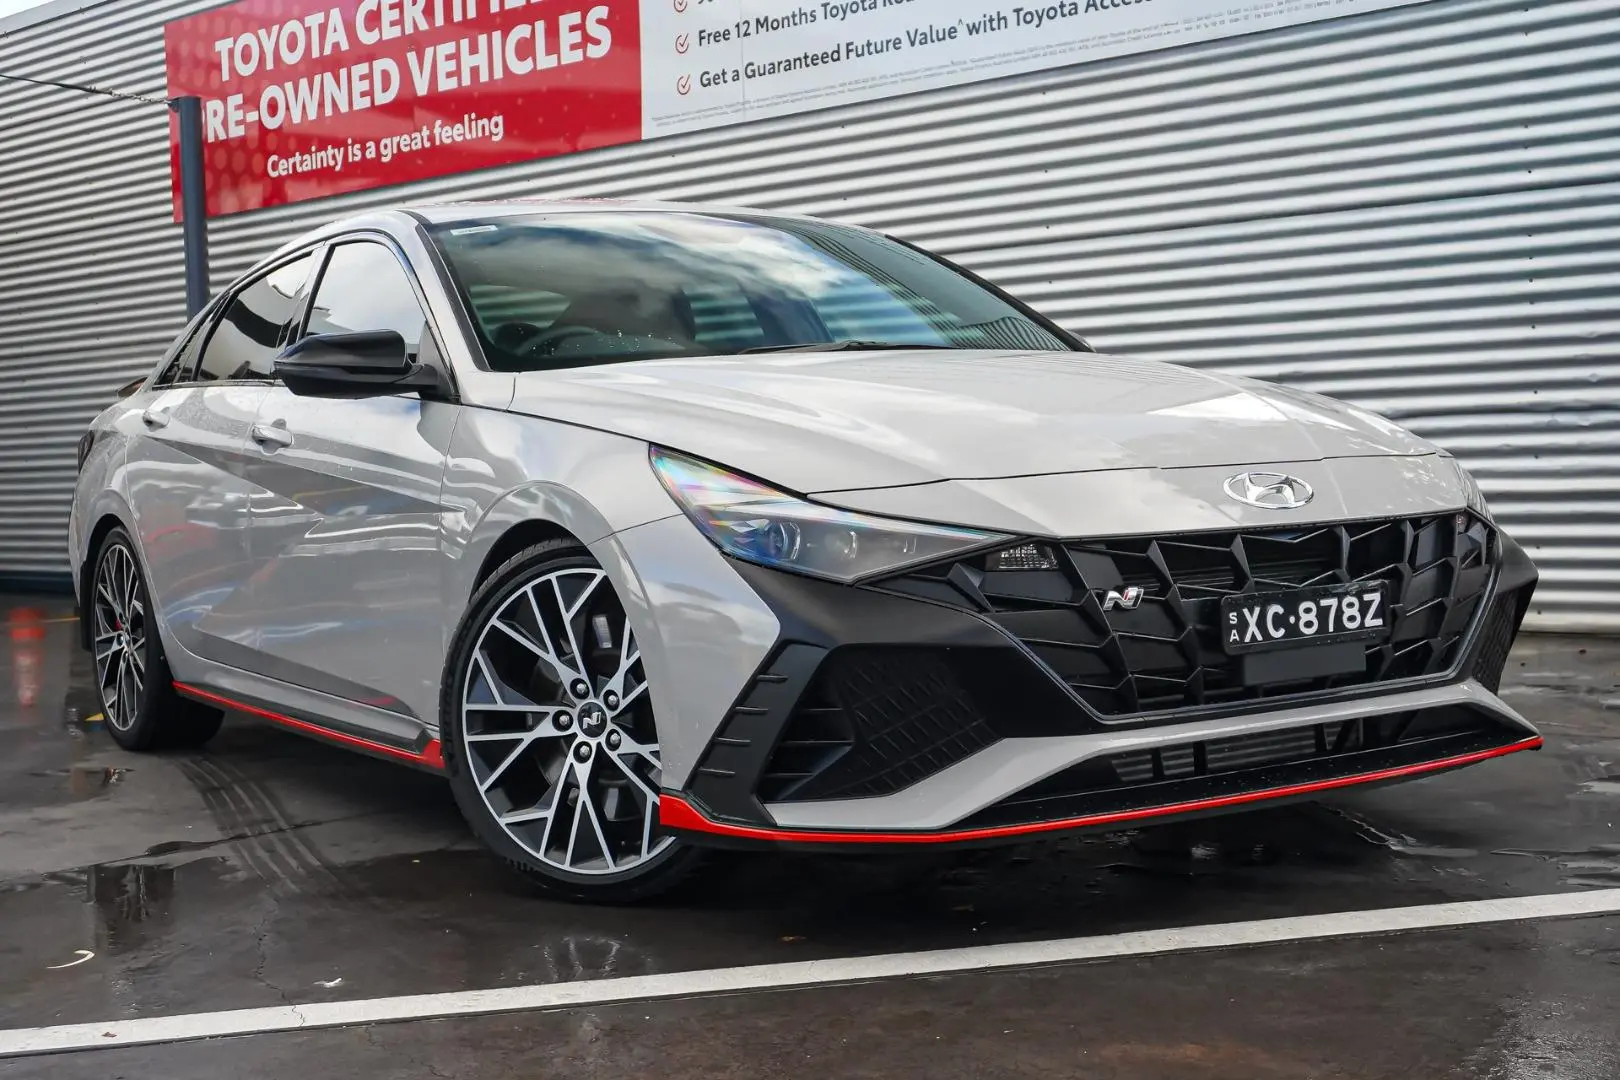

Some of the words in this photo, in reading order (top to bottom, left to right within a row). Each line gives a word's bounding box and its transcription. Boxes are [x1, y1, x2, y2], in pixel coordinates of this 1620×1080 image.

[214, 7, 350, 82] TOYOTA
[698, 29, 731, 46] Free
[735, 20, 751, 38] 12
[755, 6, 817, 34] Months
[820, 0, 877, 20] Toyota
[700, 68, 727, 87] Get
[732, 69, 740, 82] a
[744, 43, 840, 79] Guaranteed
[845, 36, 902, 59] Future
[966, 11, 1009, 36] with
[1013, 2, 1079, 28] Toyota
[1084, 0, 1152, 13] Acc
[202, 57, 400, 143] RE-OWNED
[407, 6, 612, 97] VEHICLES
[267, 147, 345, 178] Certainty
[347, 139, 363, 163] is
[365, 144, 376, 159] a
[380, 128, 431, 163] great
[434, 112, 505, 147] feeling
